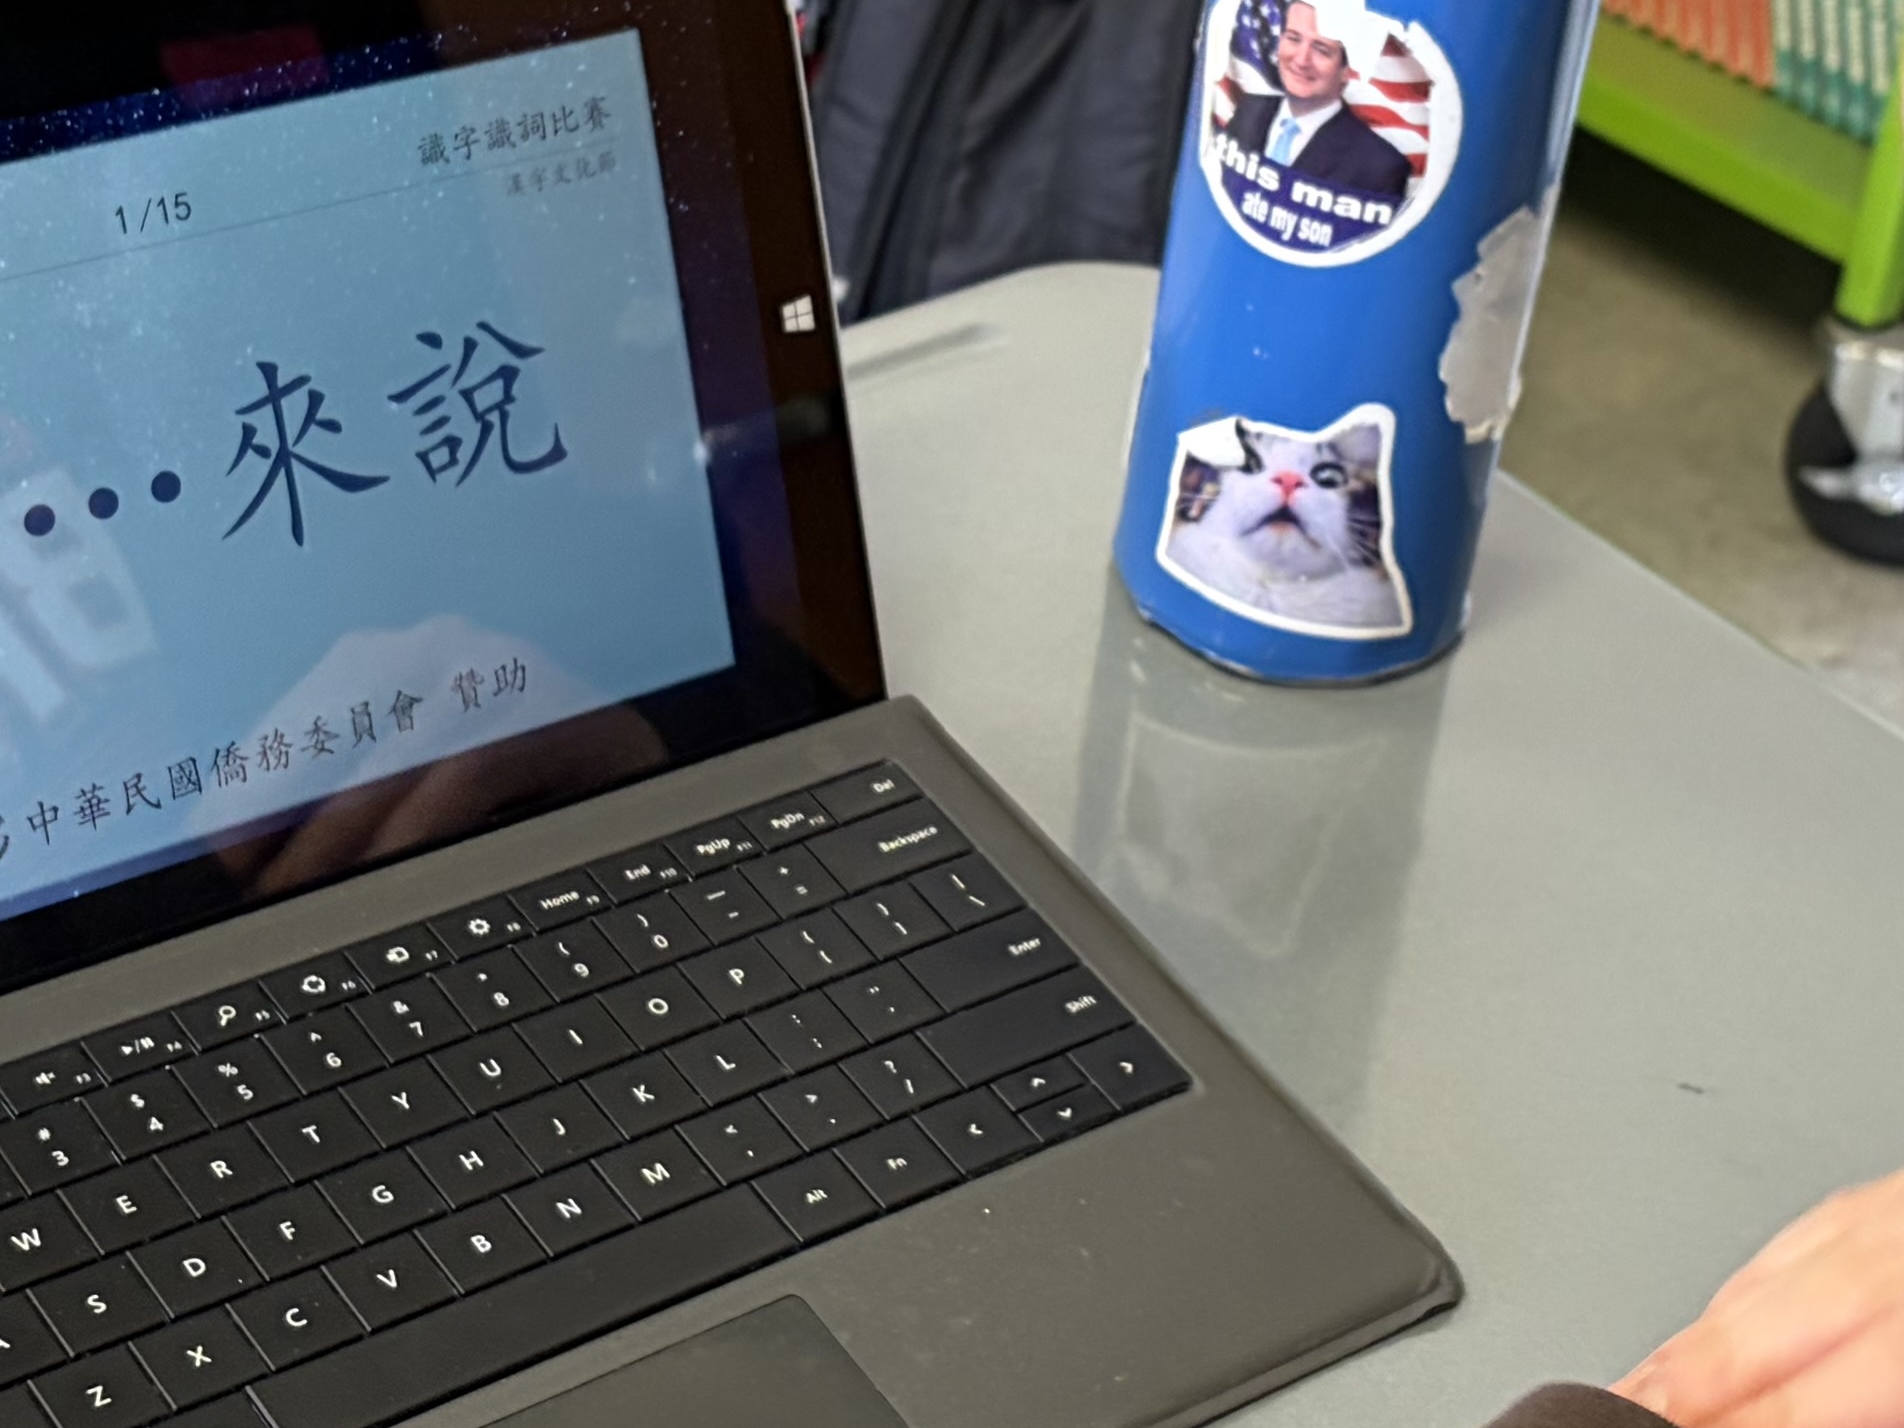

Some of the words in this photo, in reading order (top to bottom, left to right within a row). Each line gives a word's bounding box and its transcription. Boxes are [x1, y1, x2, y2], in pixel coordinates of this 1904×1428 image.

[417, 96, 612, 167] 識字識詞比賽
[1214, 134, 1280, 191] this
[1291, 180, 1392, 225] man
[1241, 192, 1269, 223] ate
[1270, 205, 1298, 241] my
[1297, 217, 1333, 247] son
[26, 689, 424, 846] 中華民國僑務委員會
[540, 891, 580, 910] Home
[696, 838, 731, 855] PgUp
[10, 1228, 42, 1251] W
[115, 1195, 137, 1214] E
[210, 1160, 233, 1179] R
[301, 1124, 321, 1143] T
[391, 1091, 410, 1110] Y
[479, 1058, 502, 1077] U
[647, 997, 669, 1015] O
[728, 968, 745, 985] P
[51, 1150, 69, 1167] 3
[149, 1116, 164, 1131] 4
[236, 1084, 254, 1100] 5
[325, 1052, 342, 1068] 6
[409, 1021, 424, 1037] 7
[493, 992, 510, 1007] 8
[573, 963, 590, 978] 9
[653, 934, 669, 949] 0
[86, 1294, 107, 1314] S
[182, 1257, 206, 1278] D
[279, 1221, 296, 1240] F
[371, 1184, 394, 1204] G
[459, 1150, 484, 1171] H
[553, 1118, 566, 1136] J
[632, 1084, 655, 1103] K
[715, 1055, 736, 1070] L
[86, 1385, 112, 1408] Z
[186, 1345, 212, 1367] X
[285, 1307, 308, 1327] C
[376, 1269, 398, 1288] V
[470, 1234, 492, 1253] B
[556, 1198, 582, 1219] N
[641, 1162, 671, 1184] M
[1065, 995, 1097, 1013] Shift
[806, 1189, 828, 1204] Alt
[887, 1157, 908, 1170] Fn
